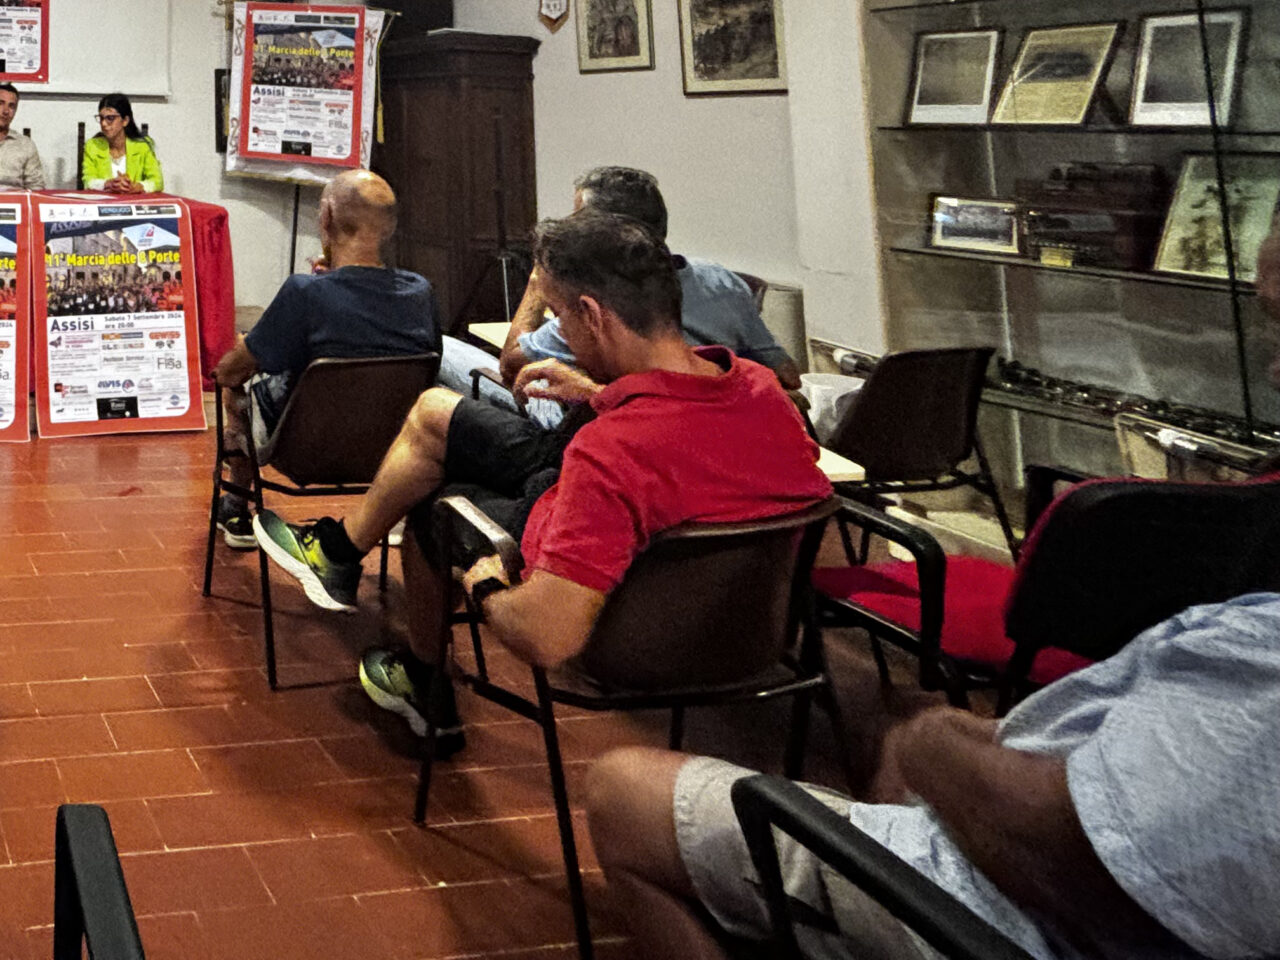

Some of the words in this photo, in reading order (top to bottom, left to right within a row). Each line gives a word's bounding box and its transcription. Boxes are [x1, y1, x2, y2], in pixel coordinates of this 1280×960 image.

[268, 45, 296, 55] Marcia
[329, 48, 354, 58] Porte
[253, 86, 285, 96] Assisi
[66, 253, 105, 267] Marcia
[107, 251, 136, 265] delle
[148, 250, 180, 263] Porte
[51, 317, 95, 332] Assisi
